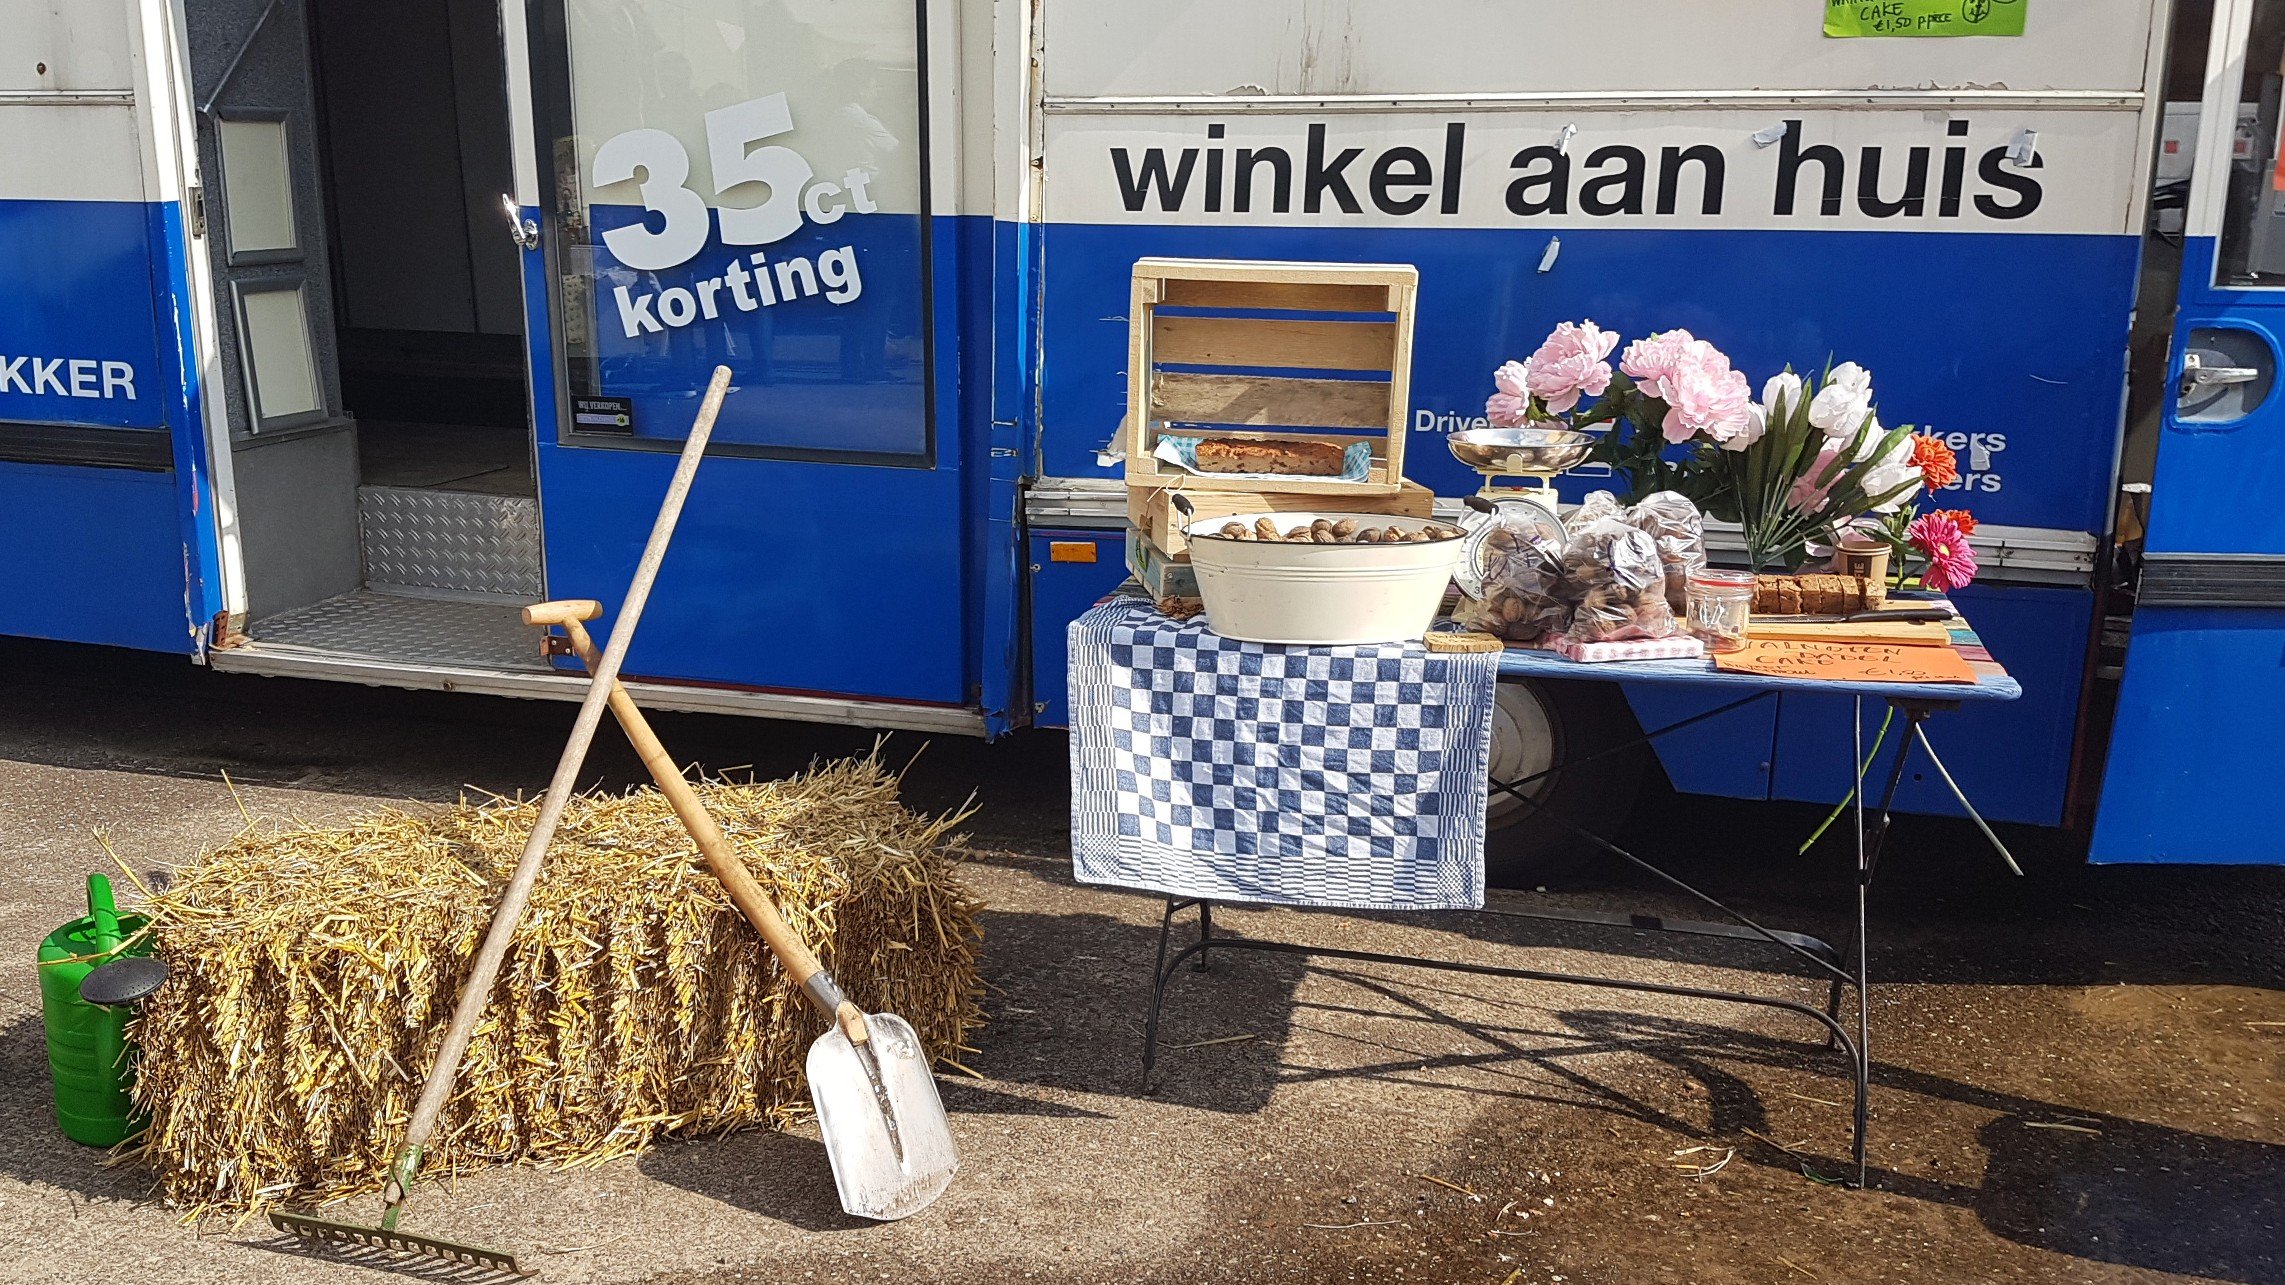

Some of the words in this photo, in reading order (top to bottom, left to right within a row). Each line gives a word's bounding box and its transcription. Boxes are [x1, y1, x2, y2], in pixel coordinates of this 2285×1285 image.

[1860, 2, 1904, 20] CAKE
[1110, 122, 1466, 216] winkel
[1505, 145, 1726, 217] aan
[1772, 118, 2044, 221] huis
[612, 246, 862, 338] korting
[1415, 409, 1490, 432] Drive
